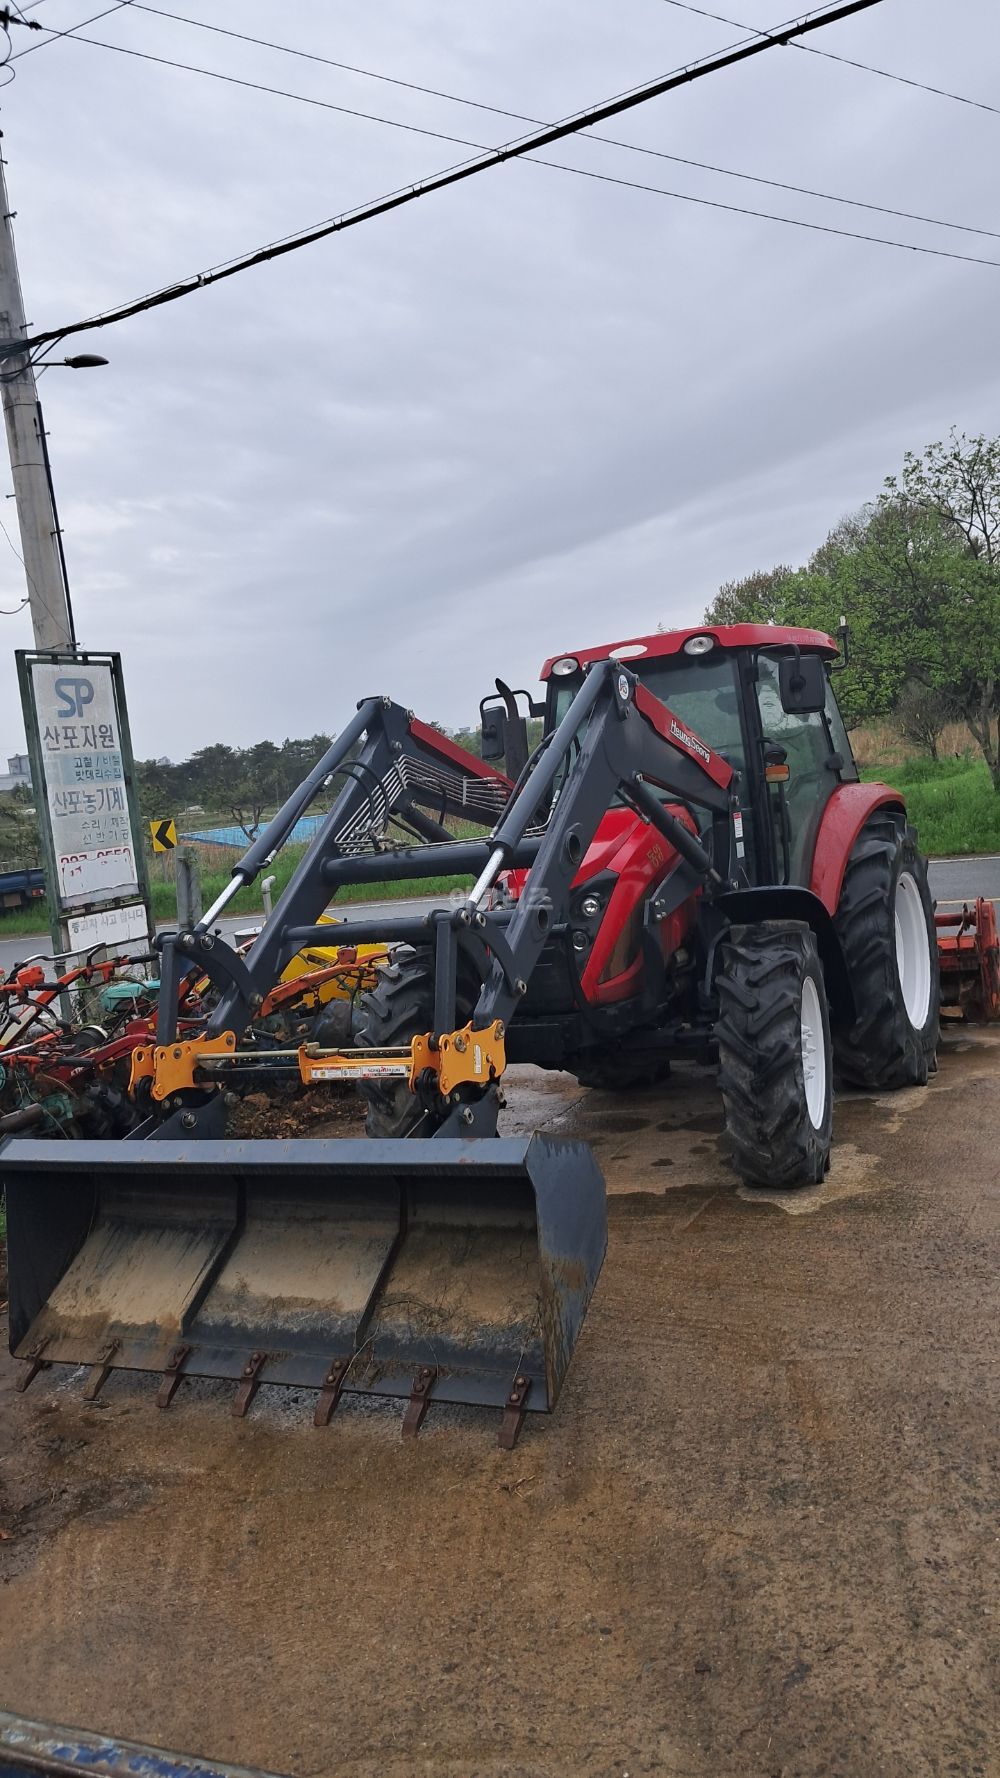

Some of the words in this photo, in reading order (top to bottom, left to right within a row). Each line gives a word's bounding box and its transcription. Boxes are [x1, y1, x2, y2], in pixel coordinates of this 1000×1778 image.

[55, 677, 95, 718] SP
[43, 724, 115, 752] 산포자원
[74, 757, 92, 768] 고철
[52, 787, 125, 817] 산포농기계
